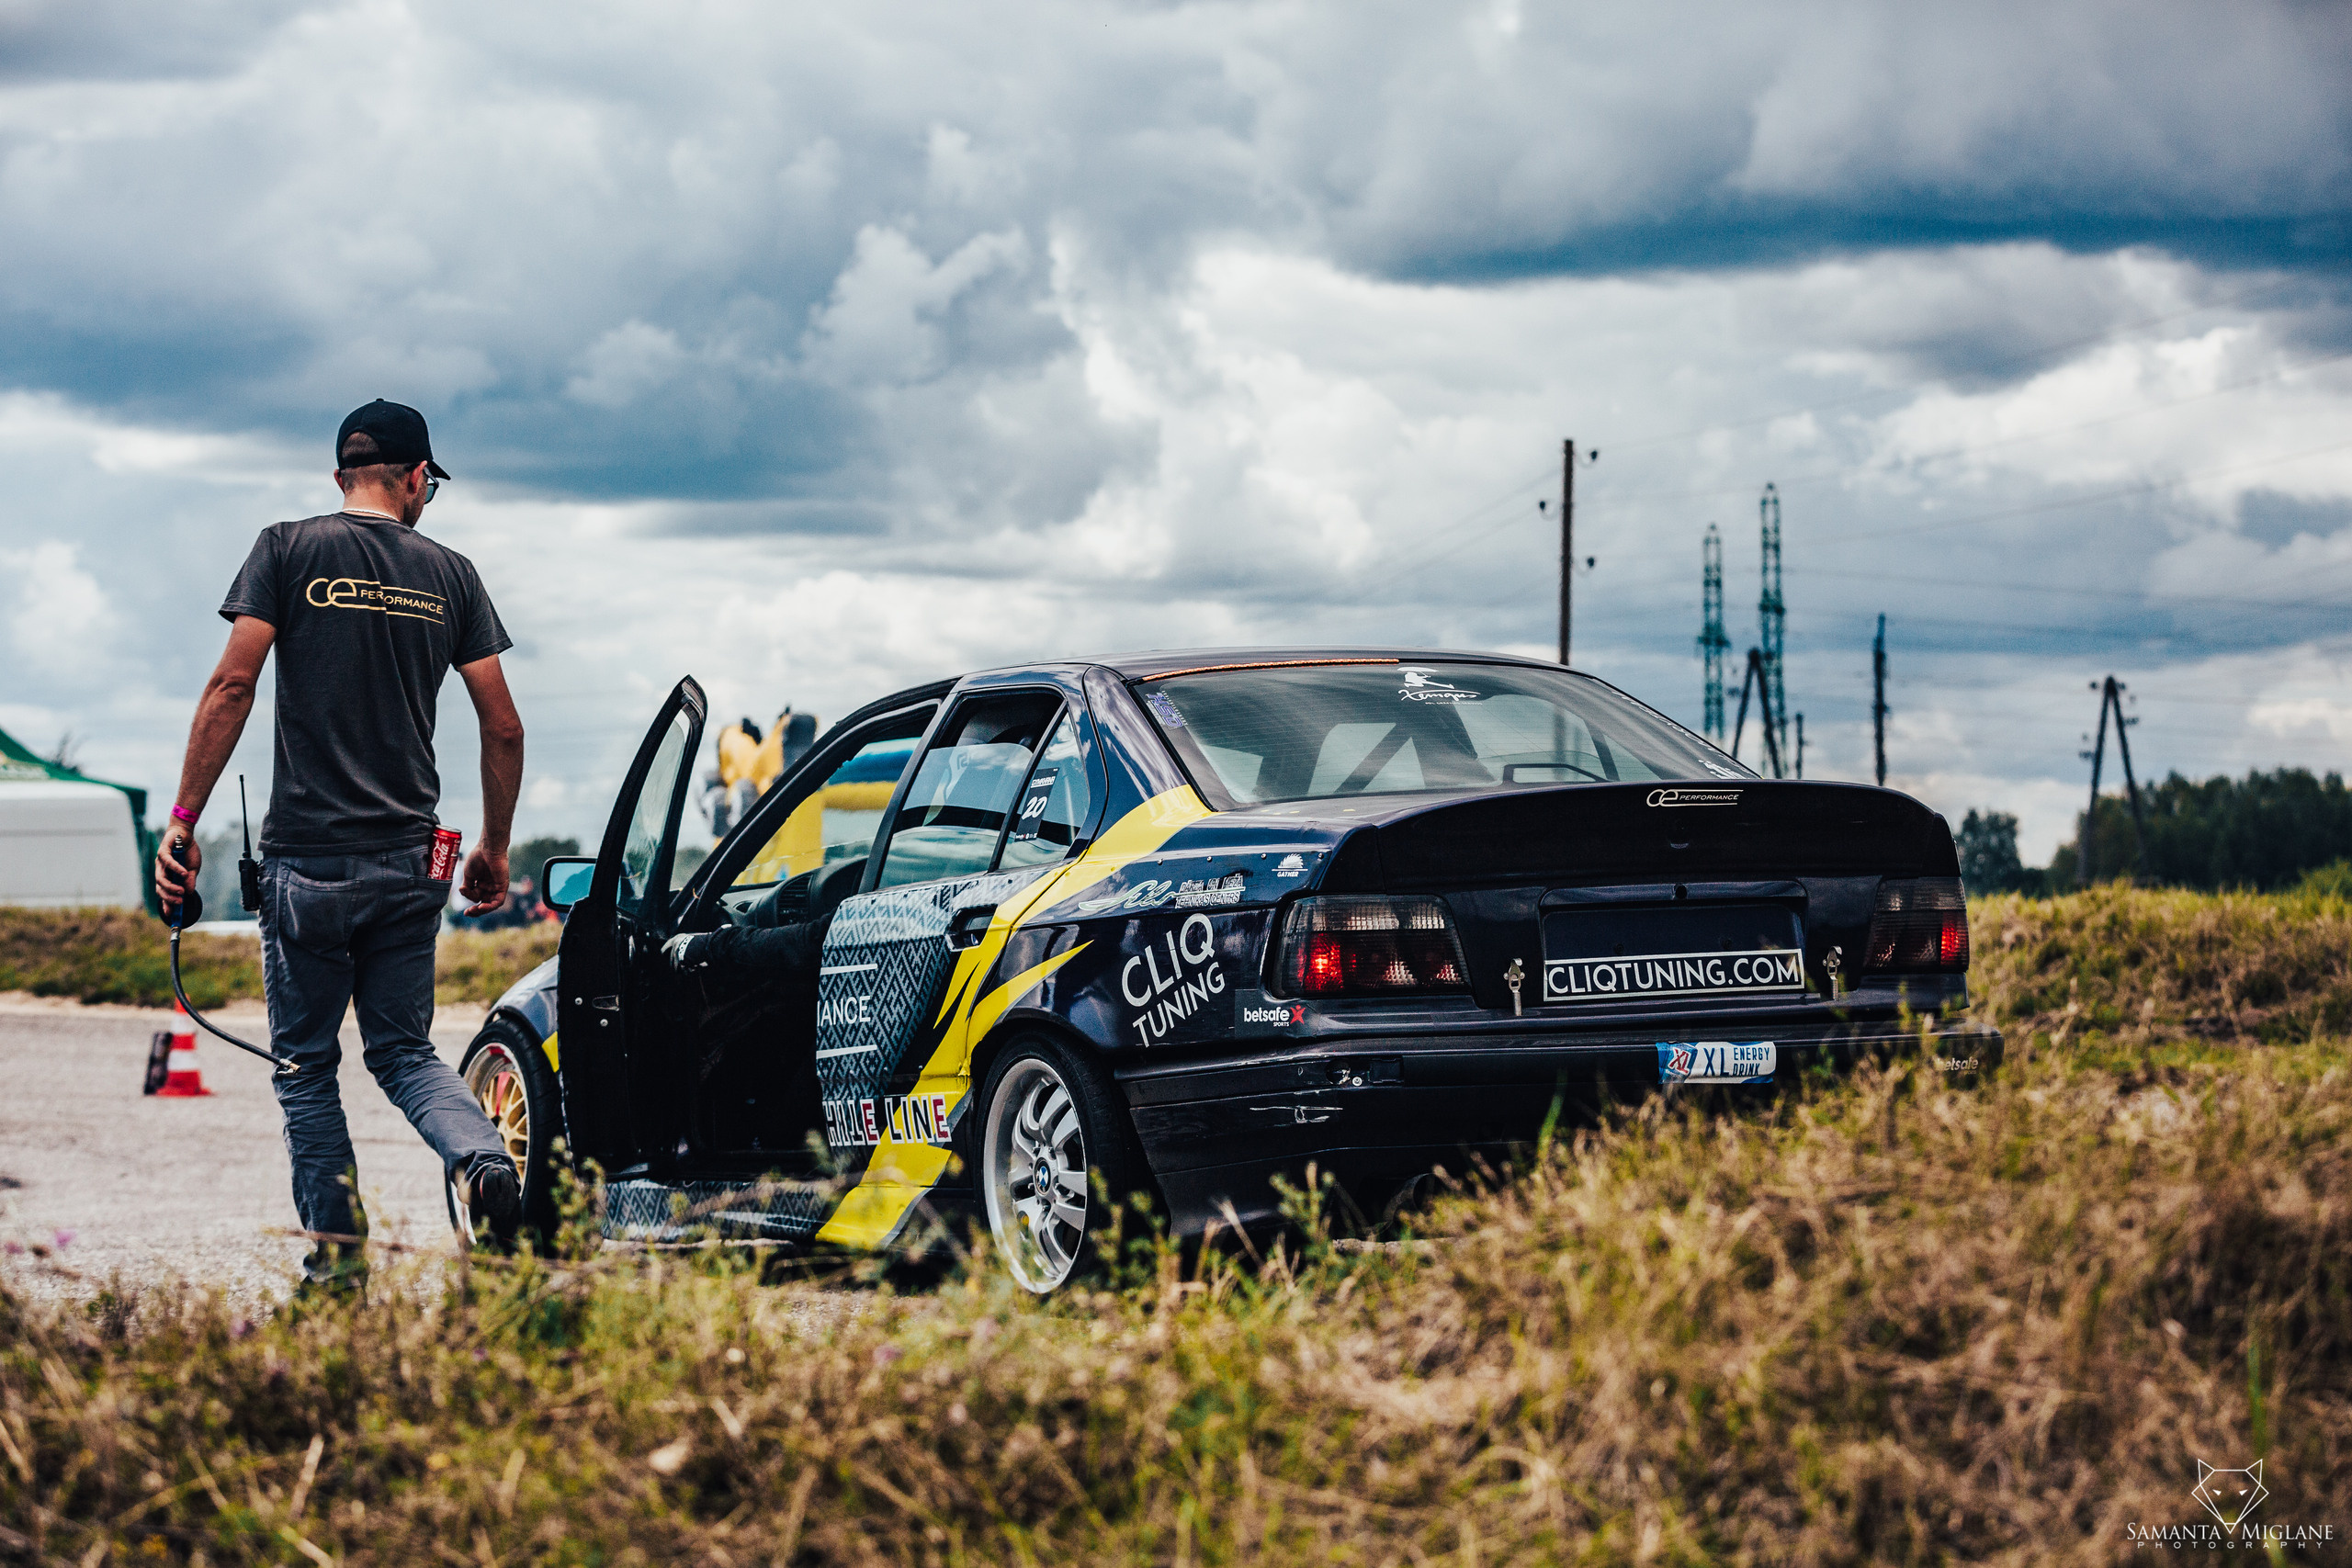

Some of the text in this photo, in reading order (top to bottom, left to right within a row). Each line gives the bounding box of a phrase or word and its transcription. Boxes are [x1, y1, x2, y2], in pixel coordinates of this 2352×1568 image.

[361, 590, 444, 615] PERORMANCE
[1022, 796, 1047, 820] 20
[1122, 913, 1215, 1007] CLIQ
[1548, 956, 1799, 993] CLIQTUNING.COM
[818, 996, 871, 1027] ANCE
[1132, 962, 1226, 1047] TUNING
[1244, 1007, 1290, 1021] betsafe
[1703, 1047, 1729, 1077] XL
[1734, 1047, 1770, 1061] ENERGY
[1733, 1063, 1760, 1077] DRINK
[885, 1095, 952, 1144] LINE
